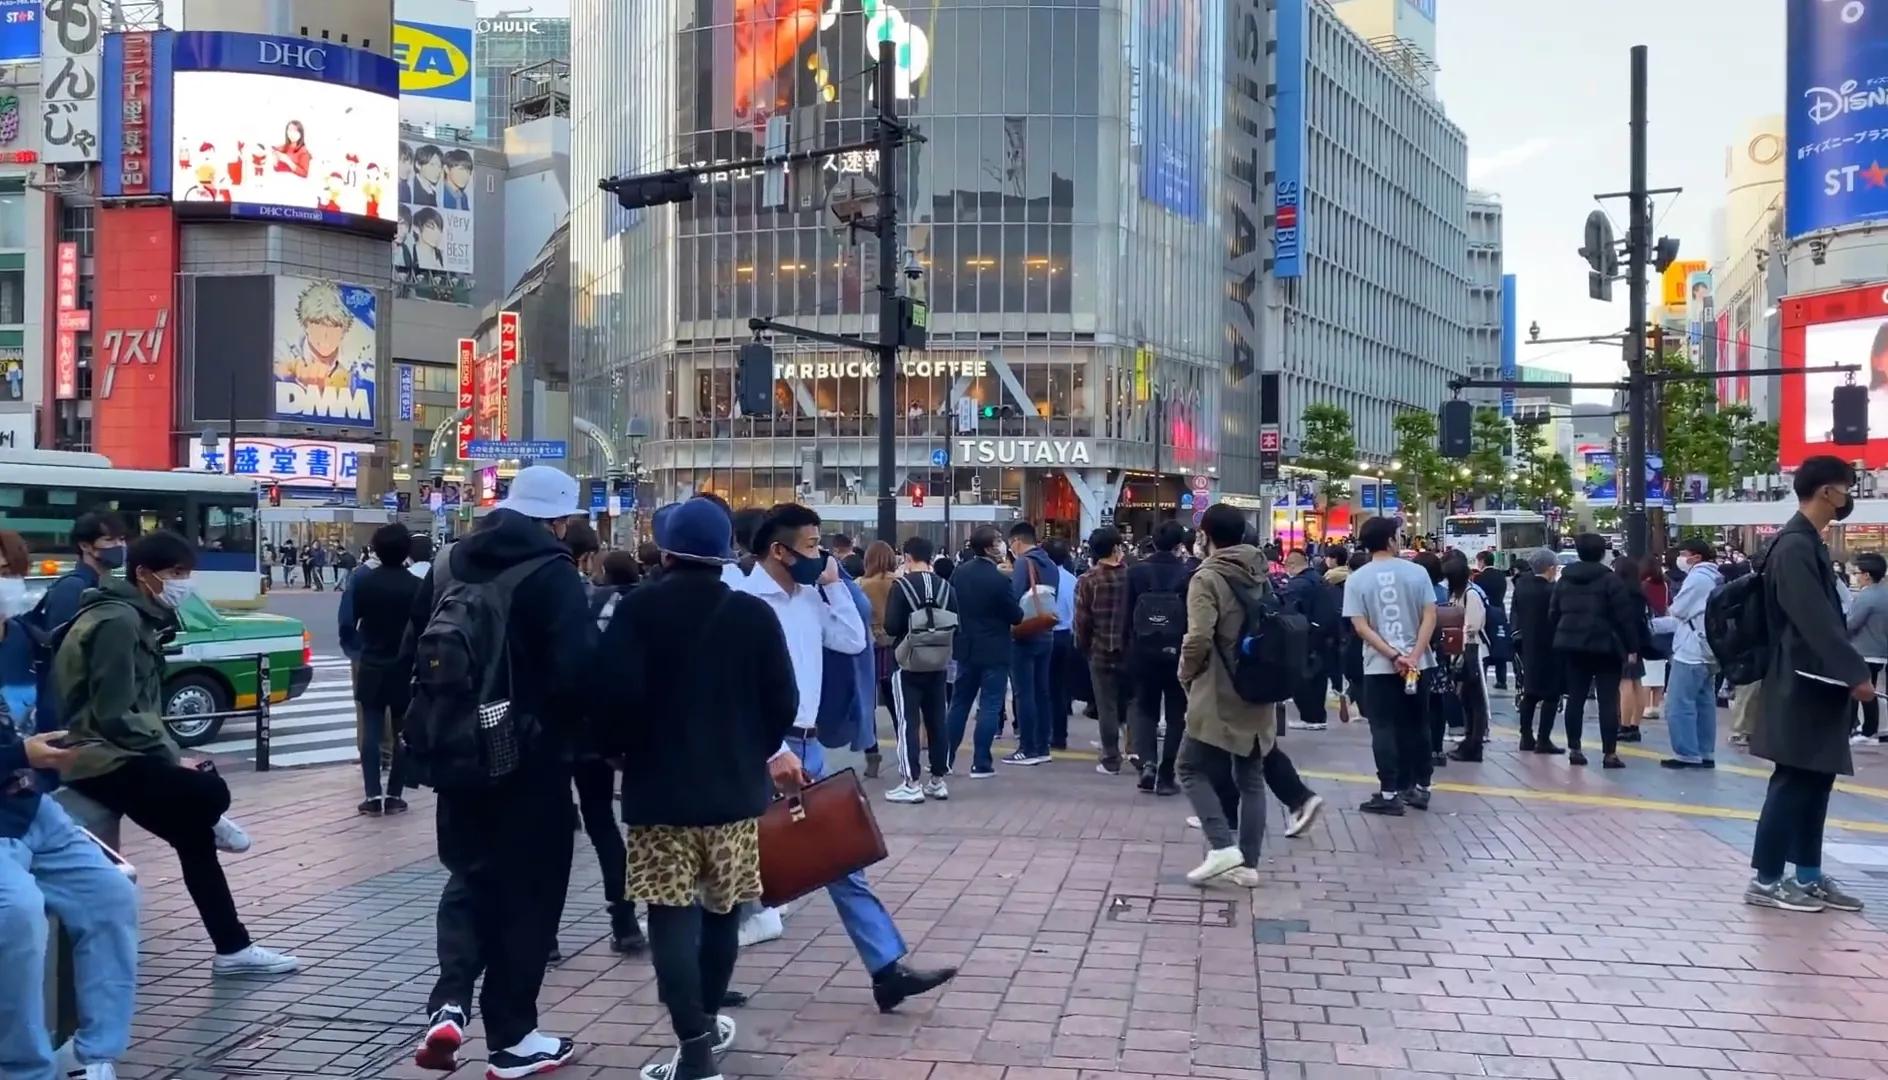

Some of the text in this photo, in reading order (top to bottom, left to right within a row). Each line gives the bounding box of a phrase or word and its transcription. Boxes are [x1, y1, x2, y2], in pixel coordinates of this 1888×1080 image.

[493, 21, 538, 33] HULIC
[259, 40, 327, 71] DHC
[45, 0, 97, 157] もんじゃ
[1228, 0, 1258, 388] SUTAYA
[259, 206, 281, 217] DHC
[1276, 180, 1297, 260] SEIBU
[446, 242, 470, 257] BEST
[101, 308, 168, 399] クスリ
[773, 361, 987, 379] TARBUCK COFFEE
[276, 381, 372, 420] DMM
[958, 440, 1090, 464] TSUTAYA
